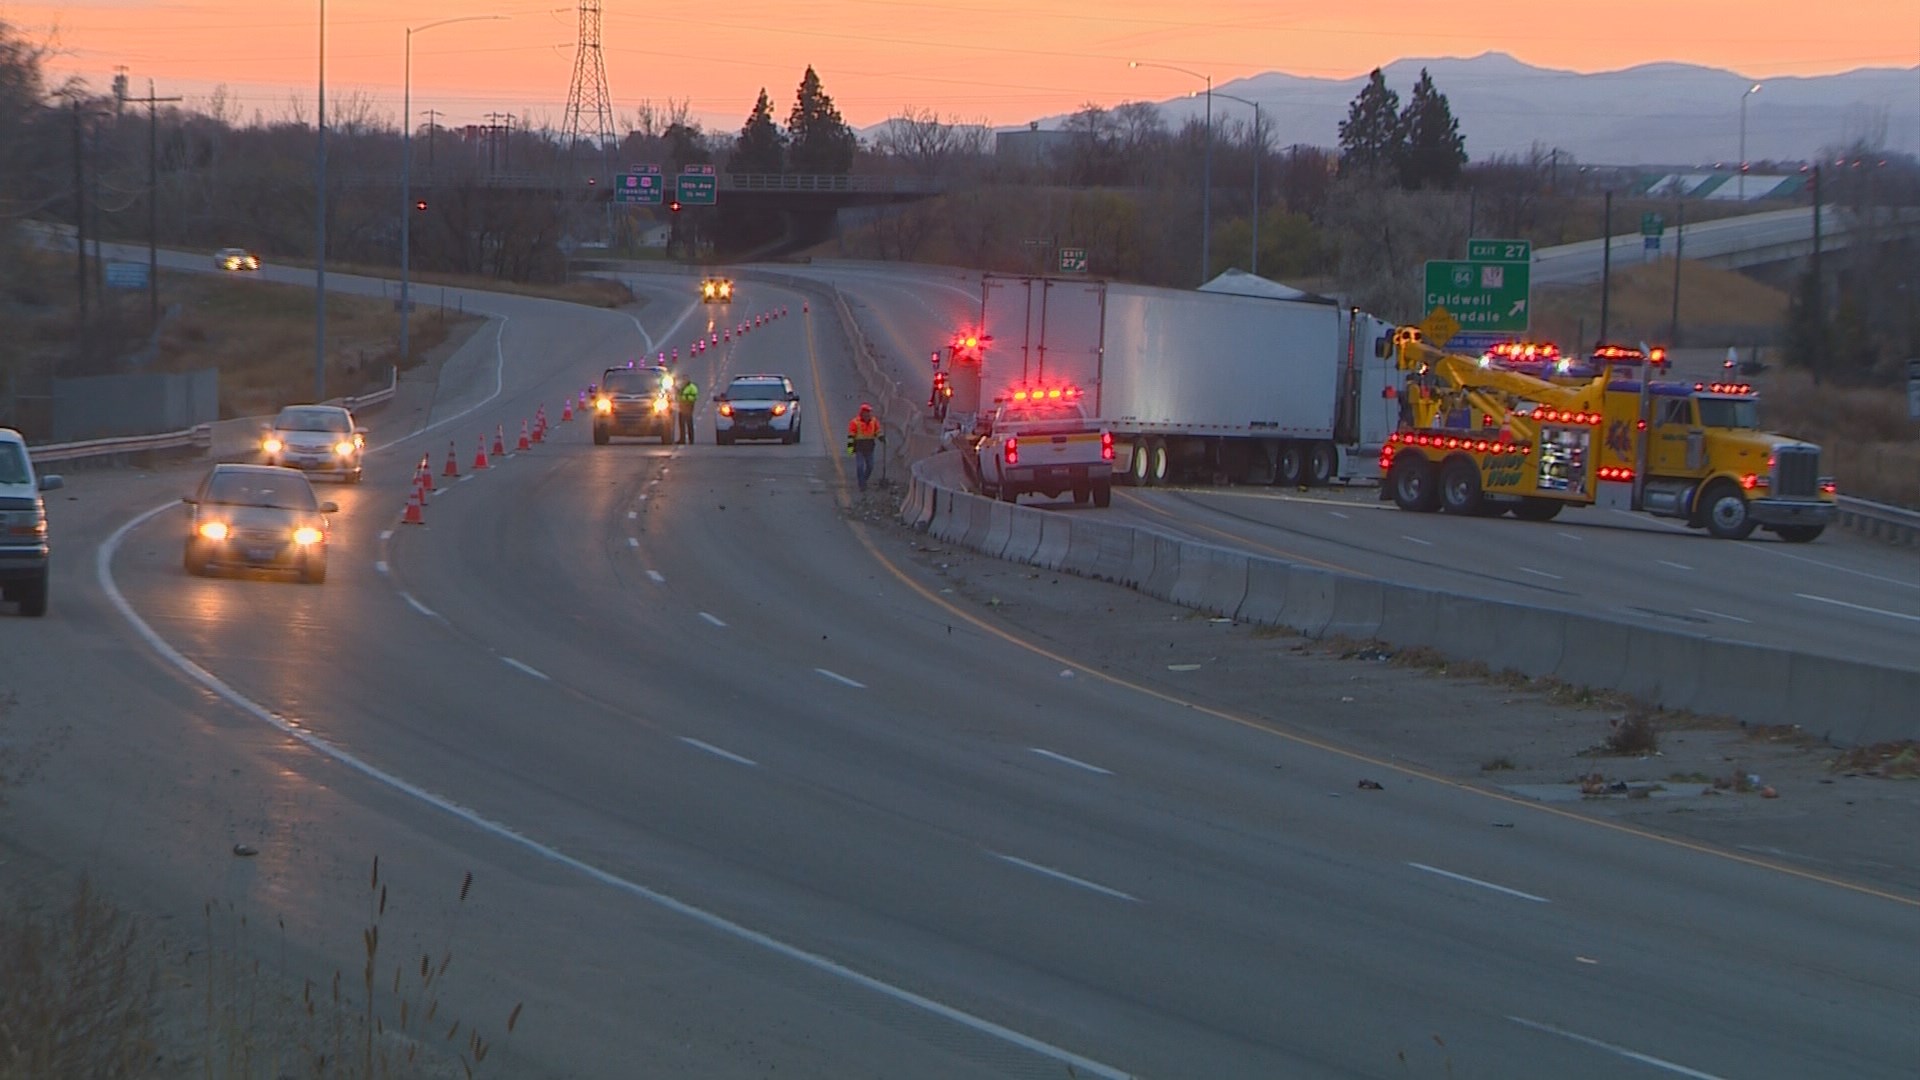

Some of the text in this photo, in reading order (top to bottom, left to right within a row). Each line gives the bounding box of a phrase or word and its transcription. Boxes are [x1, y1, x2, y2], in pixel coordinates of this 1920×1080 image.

[1473, 245, 1527, 258] EXIT 27
[1063, 259, 1076, 268] 27
[1455, 272, 1470, 283] 84
[1428, 294, 1492, 306] Caldwell
